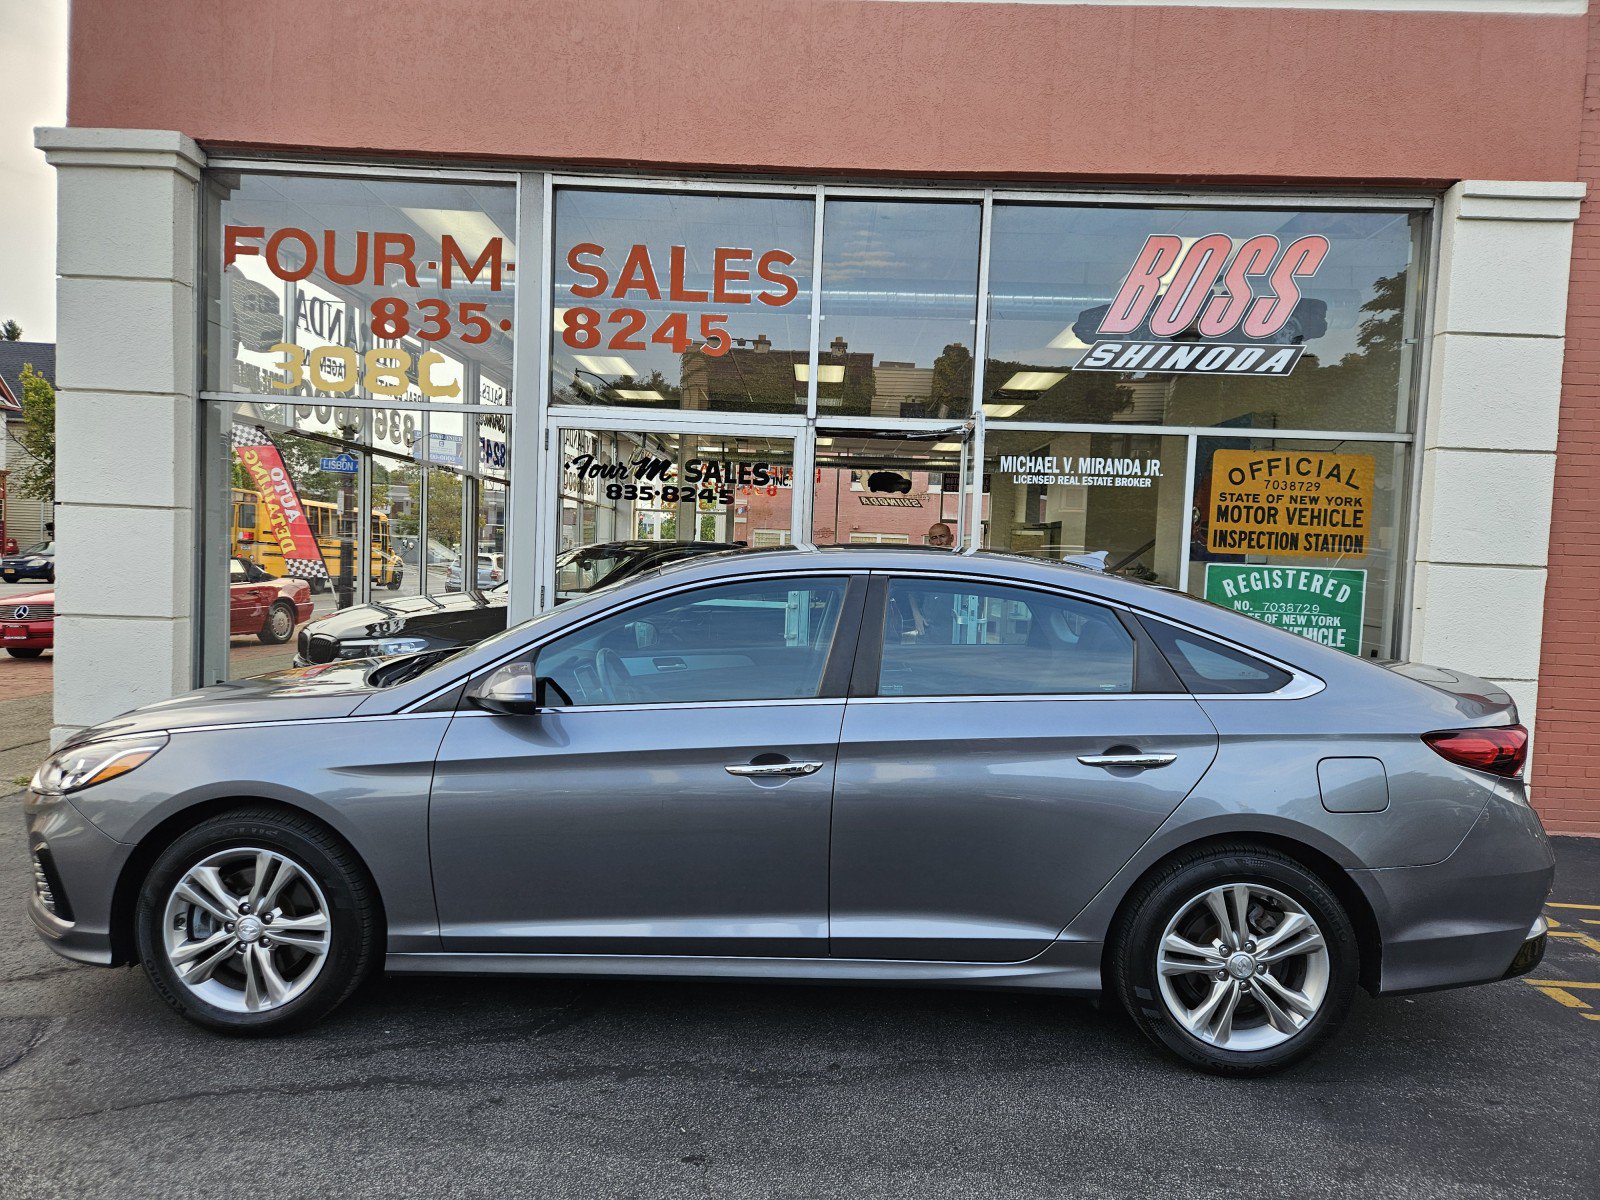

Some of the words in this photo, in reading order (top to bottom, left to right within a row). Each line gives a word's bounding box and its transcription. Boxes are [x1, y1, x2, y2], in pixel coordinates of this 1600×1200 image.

[566, 242, 798, 306] SALES
[1096, 232, 1330, 338] BOSS
[562, 307, 732, 357] 8245
[1084, 343, 1293, 374] SHINODA
[322, 459, 354, 471] LISBON
[631, 456, 672, 481] M
[685, 459, 771, 486] SALES
[772, 476, 792, 487] INC.
[1000, 455, 1060, 474] MICHAEL
[1063, 456, 1075, 474] V.
[1078, 457, 1142, 476] MIRANDA
[1144, 459, 1164, 477] JR.
[1228, 457, 1360, 490] OFFICIAL
[1013, 475, 1056, 485] LICENSED
[1057, 476, 1081, 486] REAL
[1082, 477, 1113, 487] ESTATE
[1114, 477, 1152, 487] BROKER
[1264, 479, 1321, 491] 7038729
[1219, 492, 1260, 504] STATE
[1266, 494, 1284, 504] OF
[1289, 495, 1320, 505] NEW
[1325, 496, 1363, 507] YORK
[1216, 505, 1278, 524] MOTOR
[1285, 507, 1364, 528] VEHICLE
[1212, 529, 1299, 550] INSPECTION
[1303, 533, 1364, 553] STATION
[1222, 570, 1351, 603] REGISTERED
[1234, 601, 1253, 611] NO.
[1262, 602, 1320, 613] 7038729
[1264, 614, 1279, 624] OF
[1282, 614, 1308, 625] NEW
[1311, 615, 1342, 627] YORK
